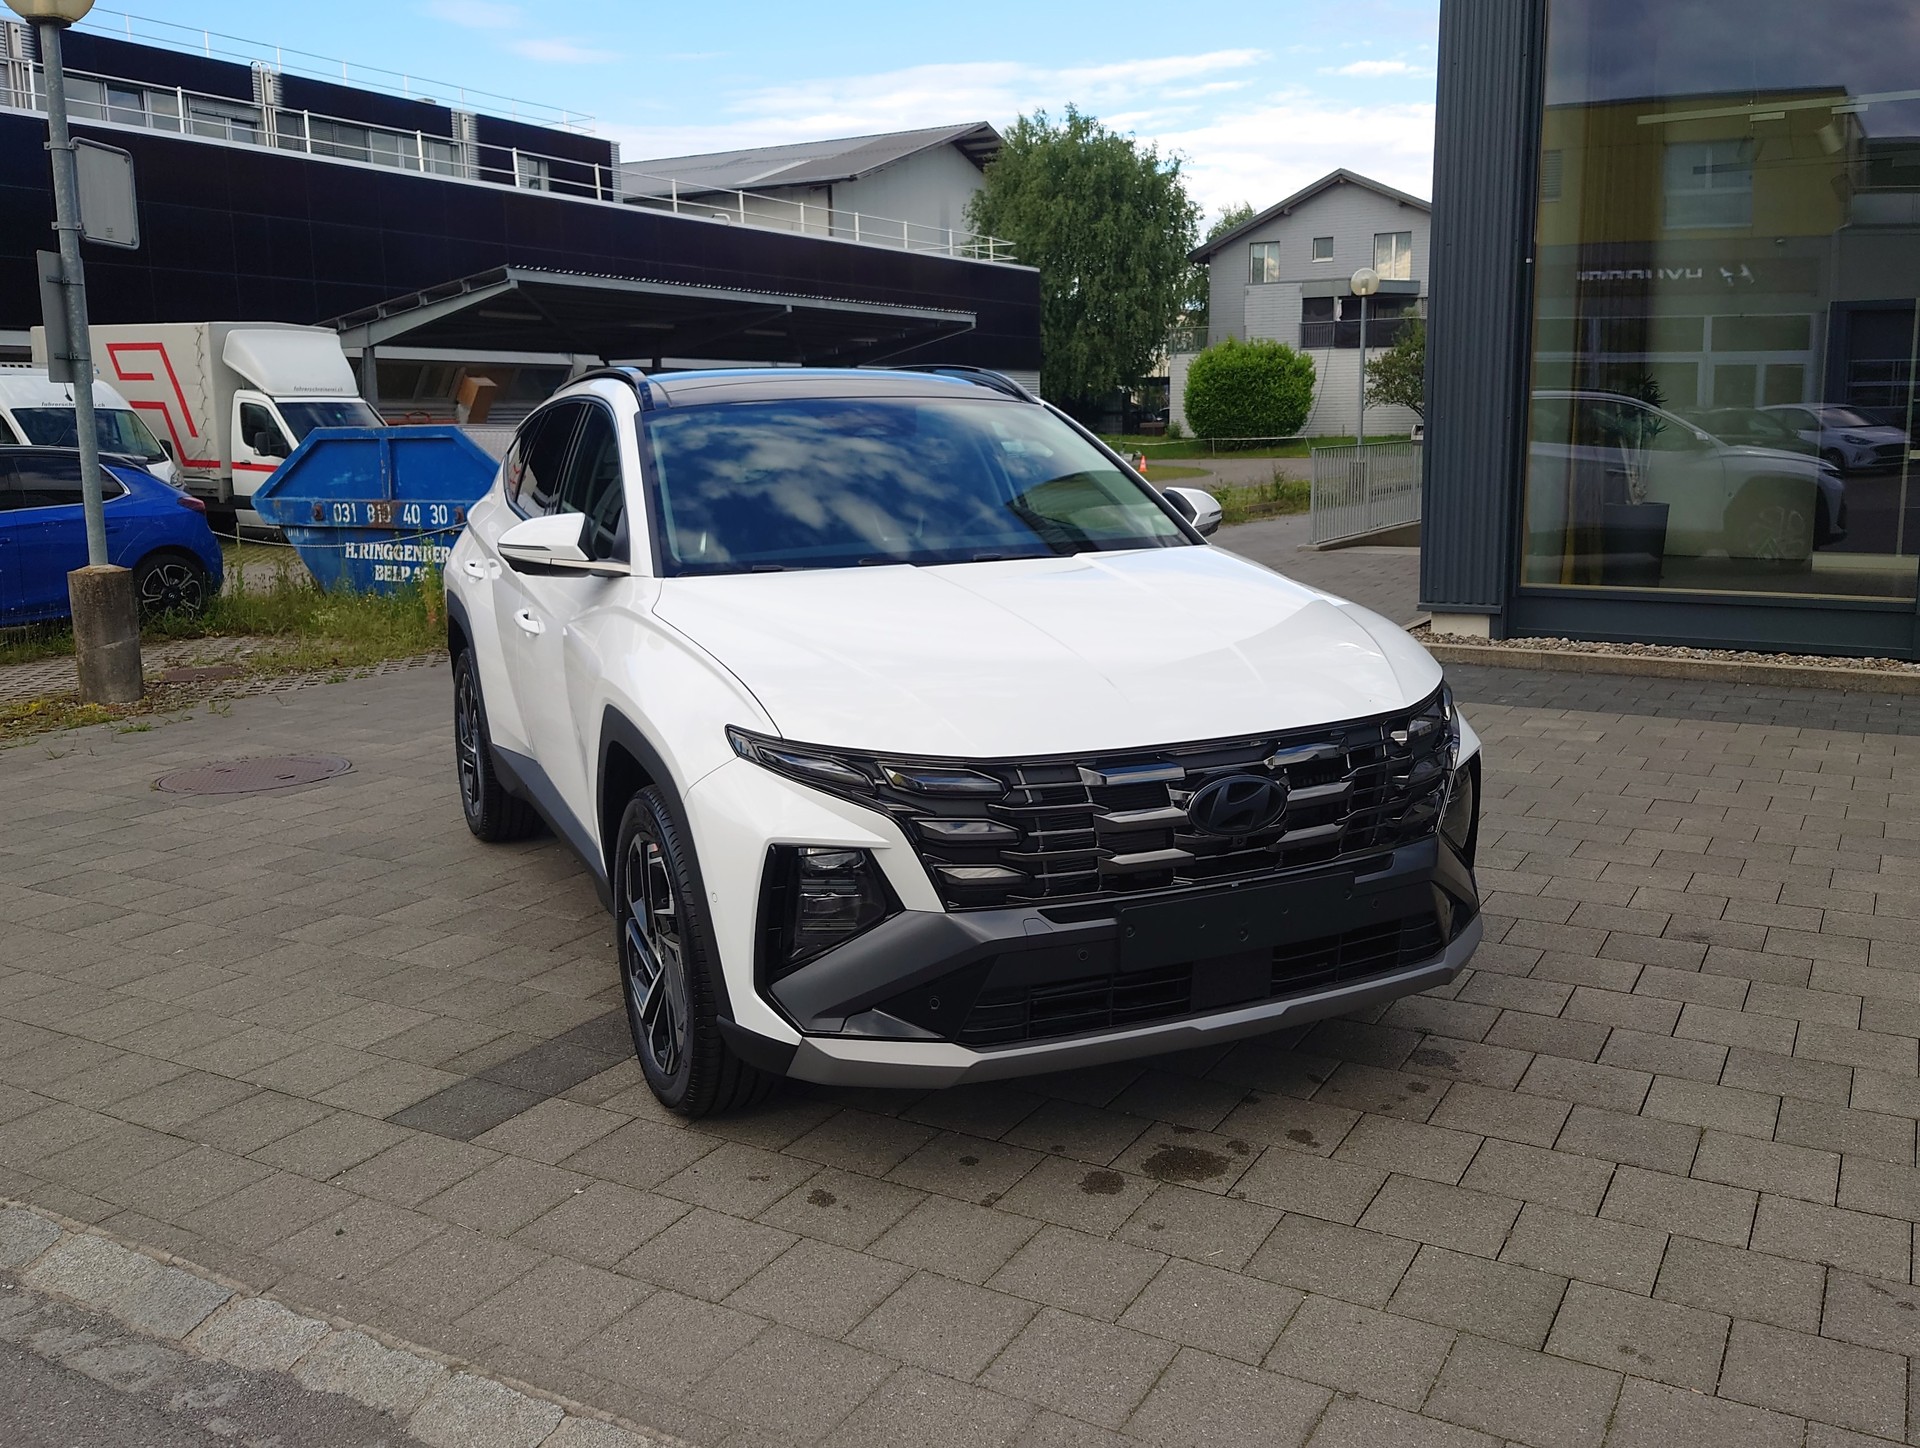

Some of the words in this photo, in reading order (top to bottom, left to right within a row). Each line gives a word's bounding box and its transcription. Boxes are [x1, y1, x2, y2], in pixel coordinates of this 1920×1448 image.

[333, 503, 357, 523] 031
[403, 503, 421, 525] 40
[429, 504, 448, 525] 30
[374, 564, 411, 583] BELP
